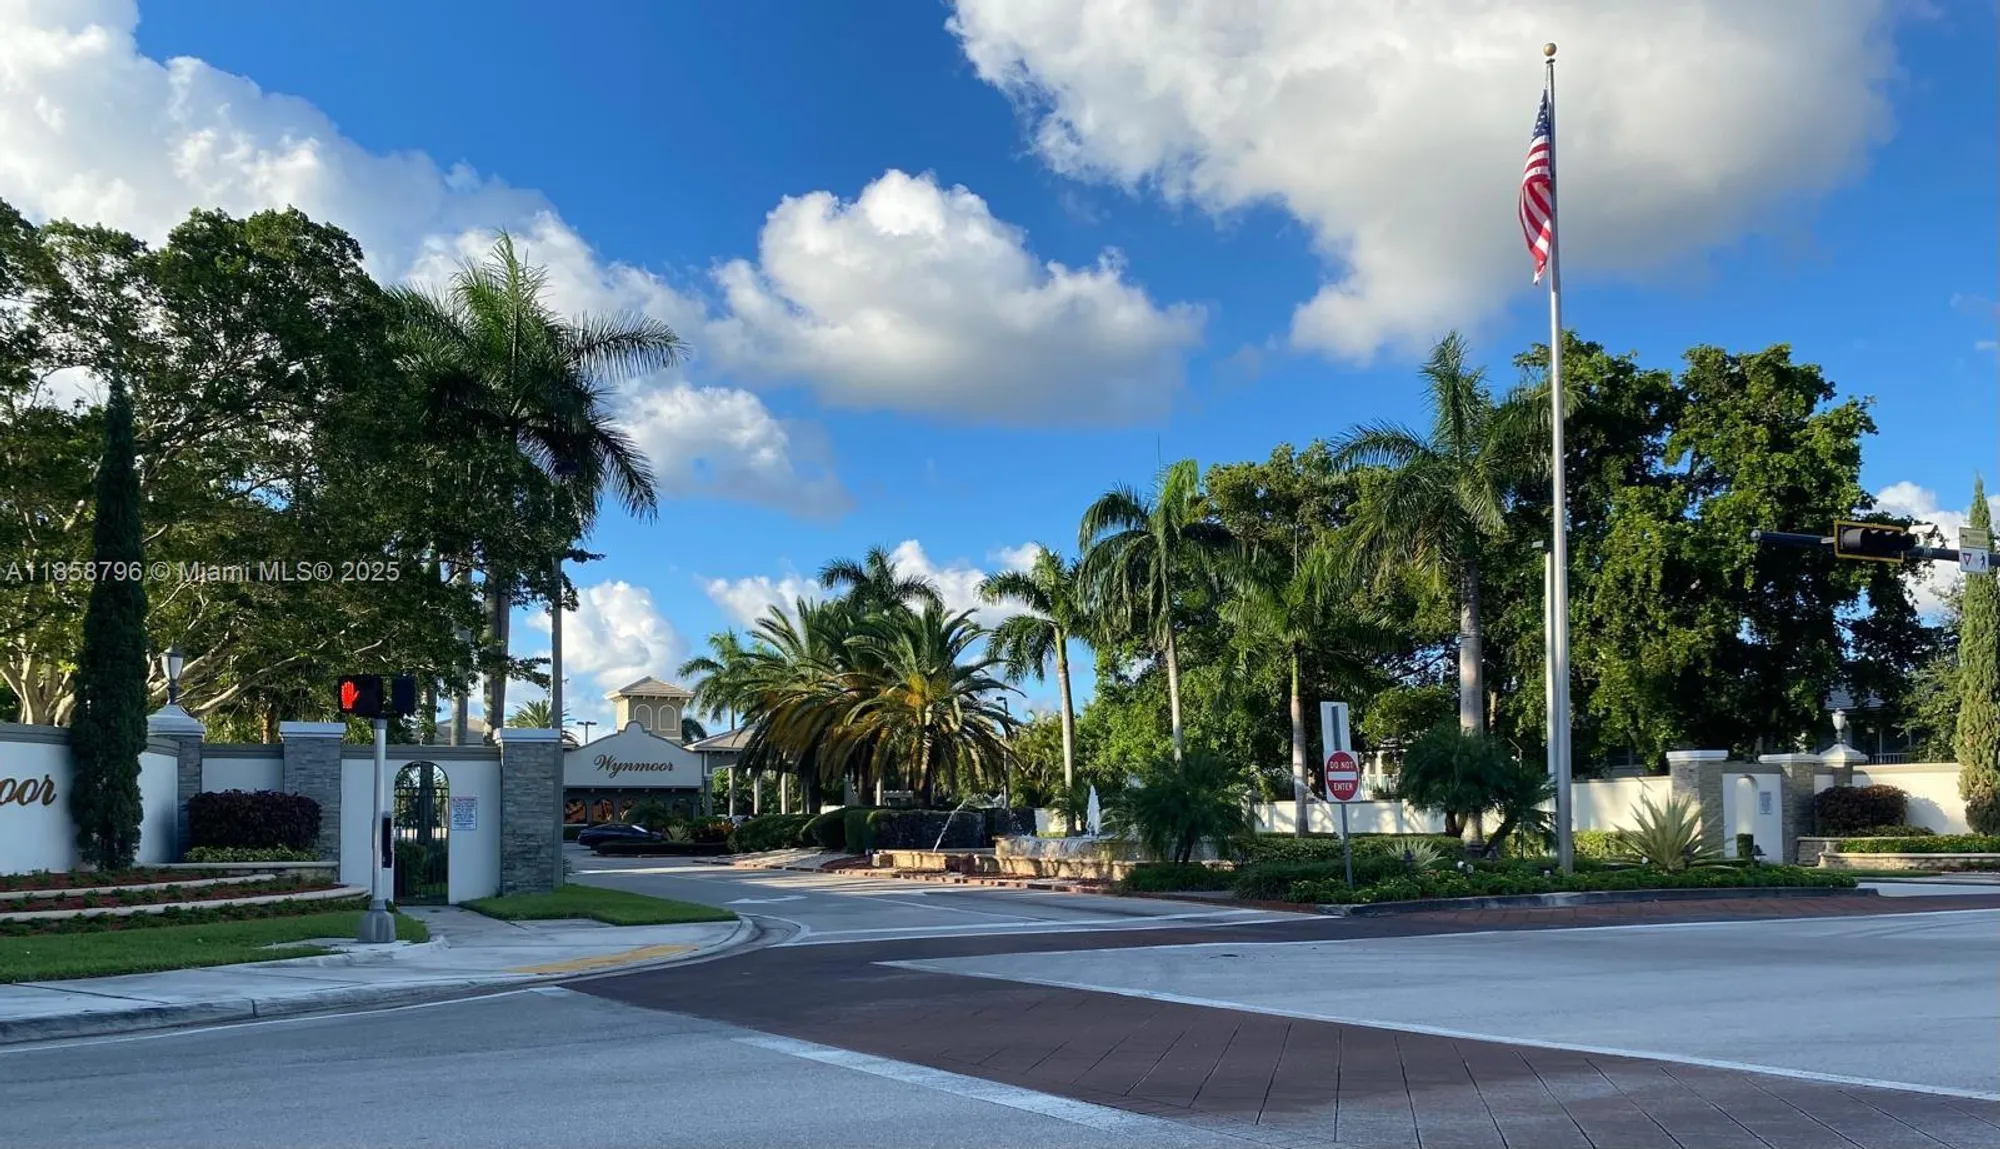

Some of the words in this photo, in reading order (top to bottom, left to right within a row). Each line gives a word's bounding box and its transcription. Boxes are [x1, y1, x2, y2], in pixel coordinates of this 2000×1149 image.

[593, 753, 674, 779] Wynmoor
[1330, 761, 1339, 769] DO
[1341, 761, 1354, 769] NOT
[1333, 782, 1353, 791] ENTER
